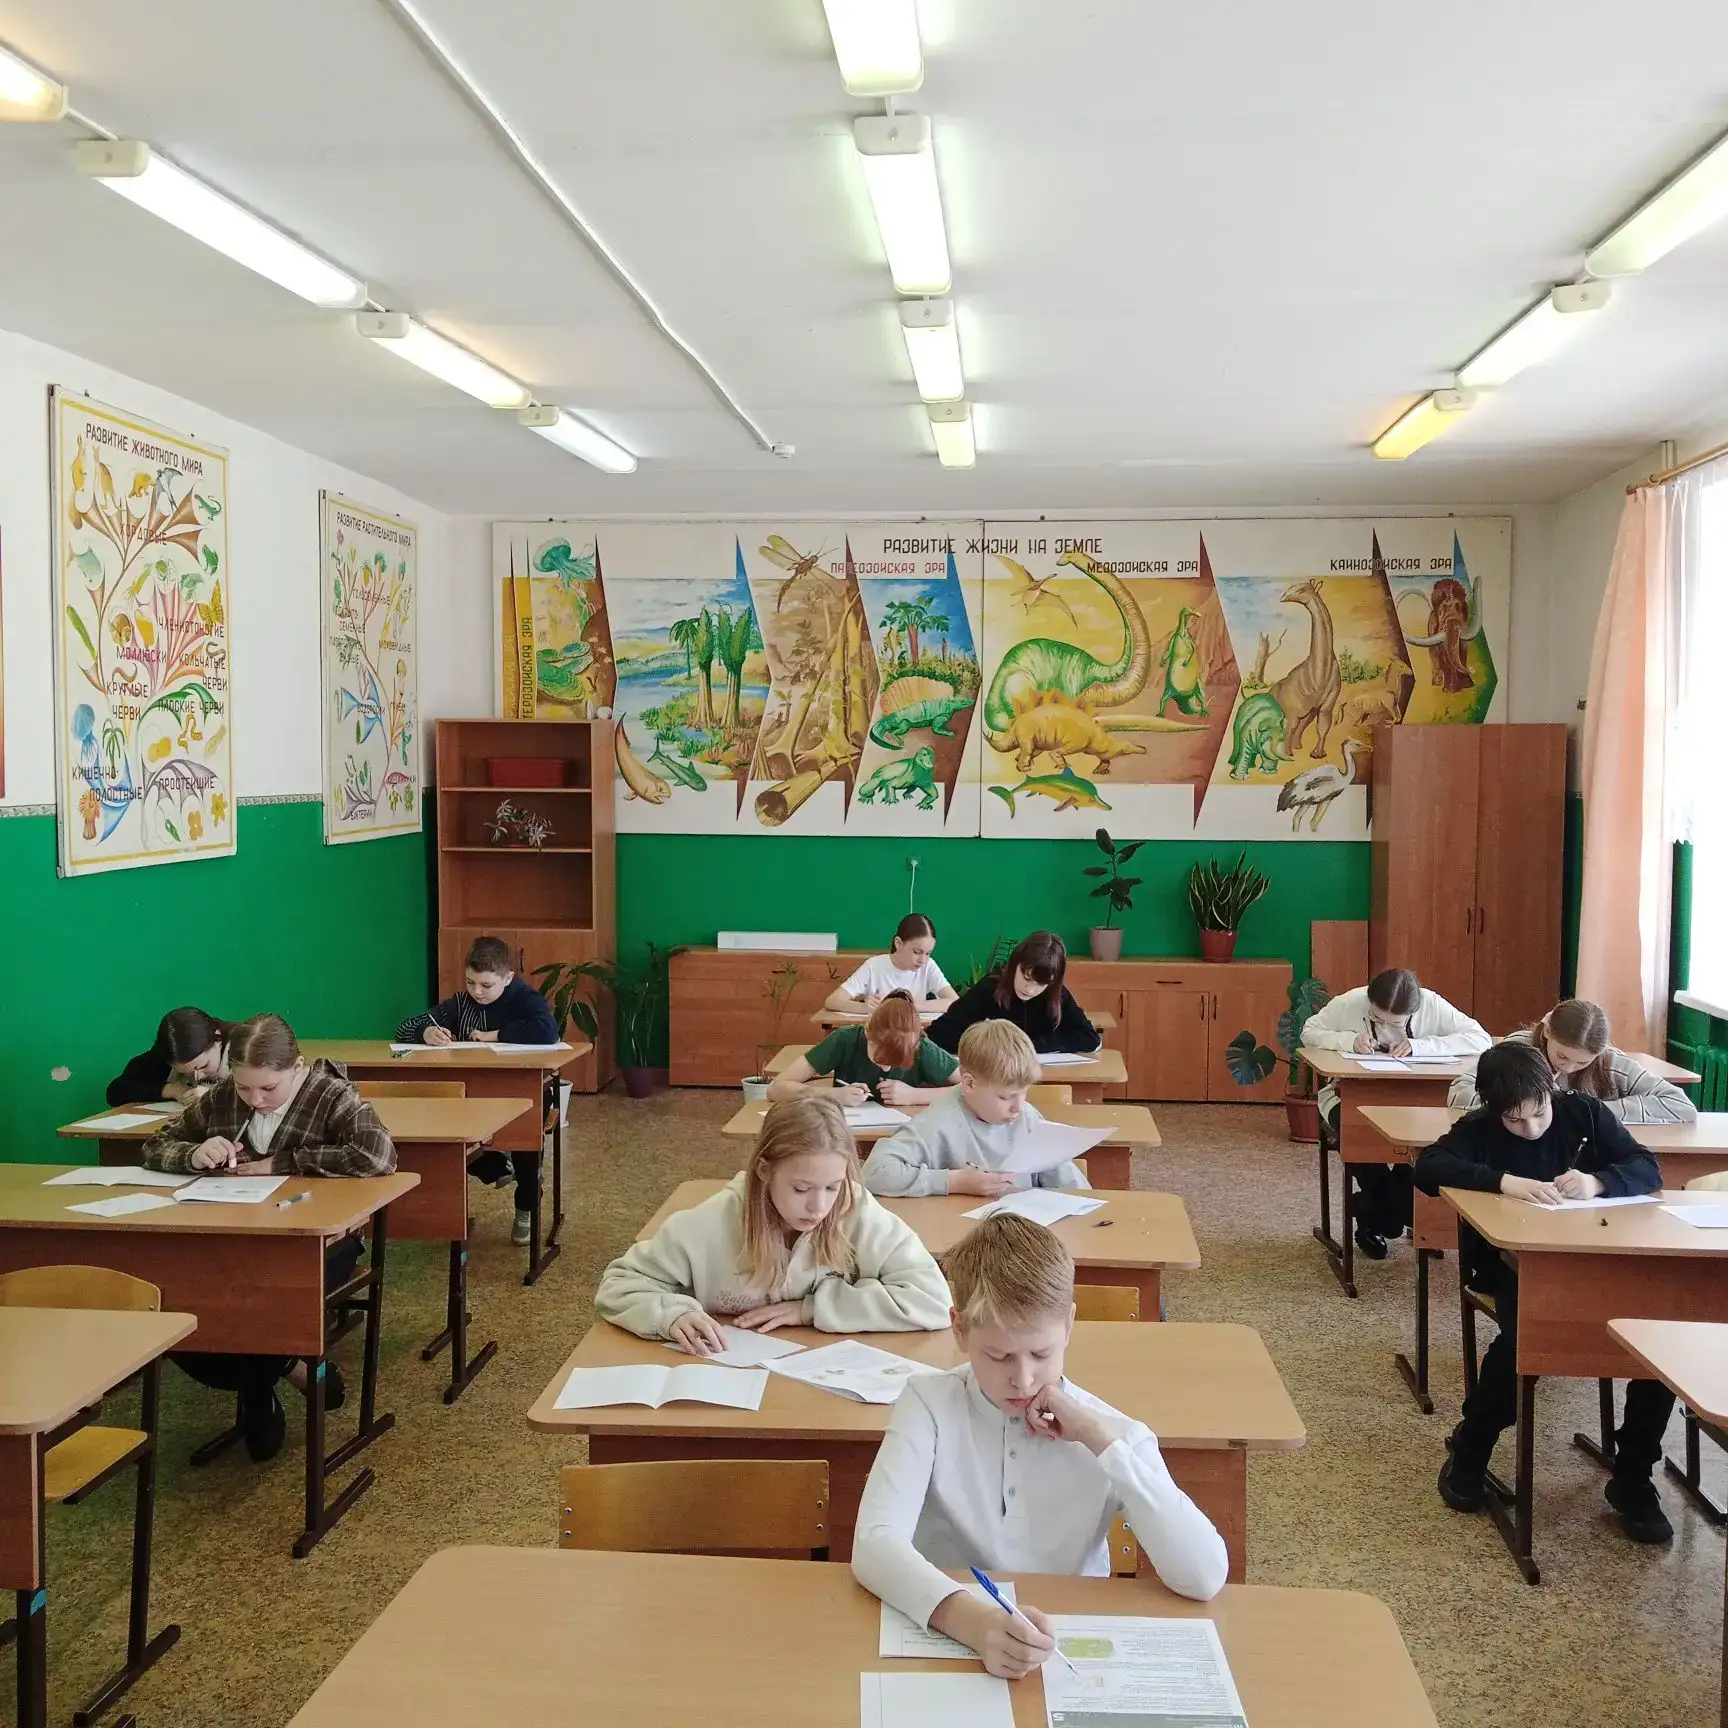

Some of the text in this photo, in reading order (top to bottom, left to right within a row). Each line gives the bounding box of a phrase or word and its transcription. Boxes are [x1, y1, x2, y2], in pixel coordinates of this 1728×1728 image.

[86, 423, 203, 476] РАЗВИТИЕ ЖИВОТНОГО МИРА
[337, 511, 361, 531] РАЗВИТИЕ
[883, 538, 1102, 554] РАЗВИТИЕ ЖИЗНИ НА ЗЕМЛЕ
[924, 562, 945, 574] ЭРА
[1176, 560, 1198, 573] ЭРА
[1430, 558, 1452, 570] ЭРА
[521, 617, 533, 638] ЭРА
[116, 646, 167, 663] МОЛЛЮСКИ
[180, 653, 226, 670] КОЛЬЧАТЫЕ
[106, 681, 148, 698] КРУГЛЫЕ
[202, 676, 227, 692] ЧЕРВИ
[112, 705, 140, 720] ЧЕРВИ
[159, 700, 225, 715] ПЛОСКИЕ ЧЕРВИ
[90, 786, 142, 801] ПОЛОСТНЫЕ
